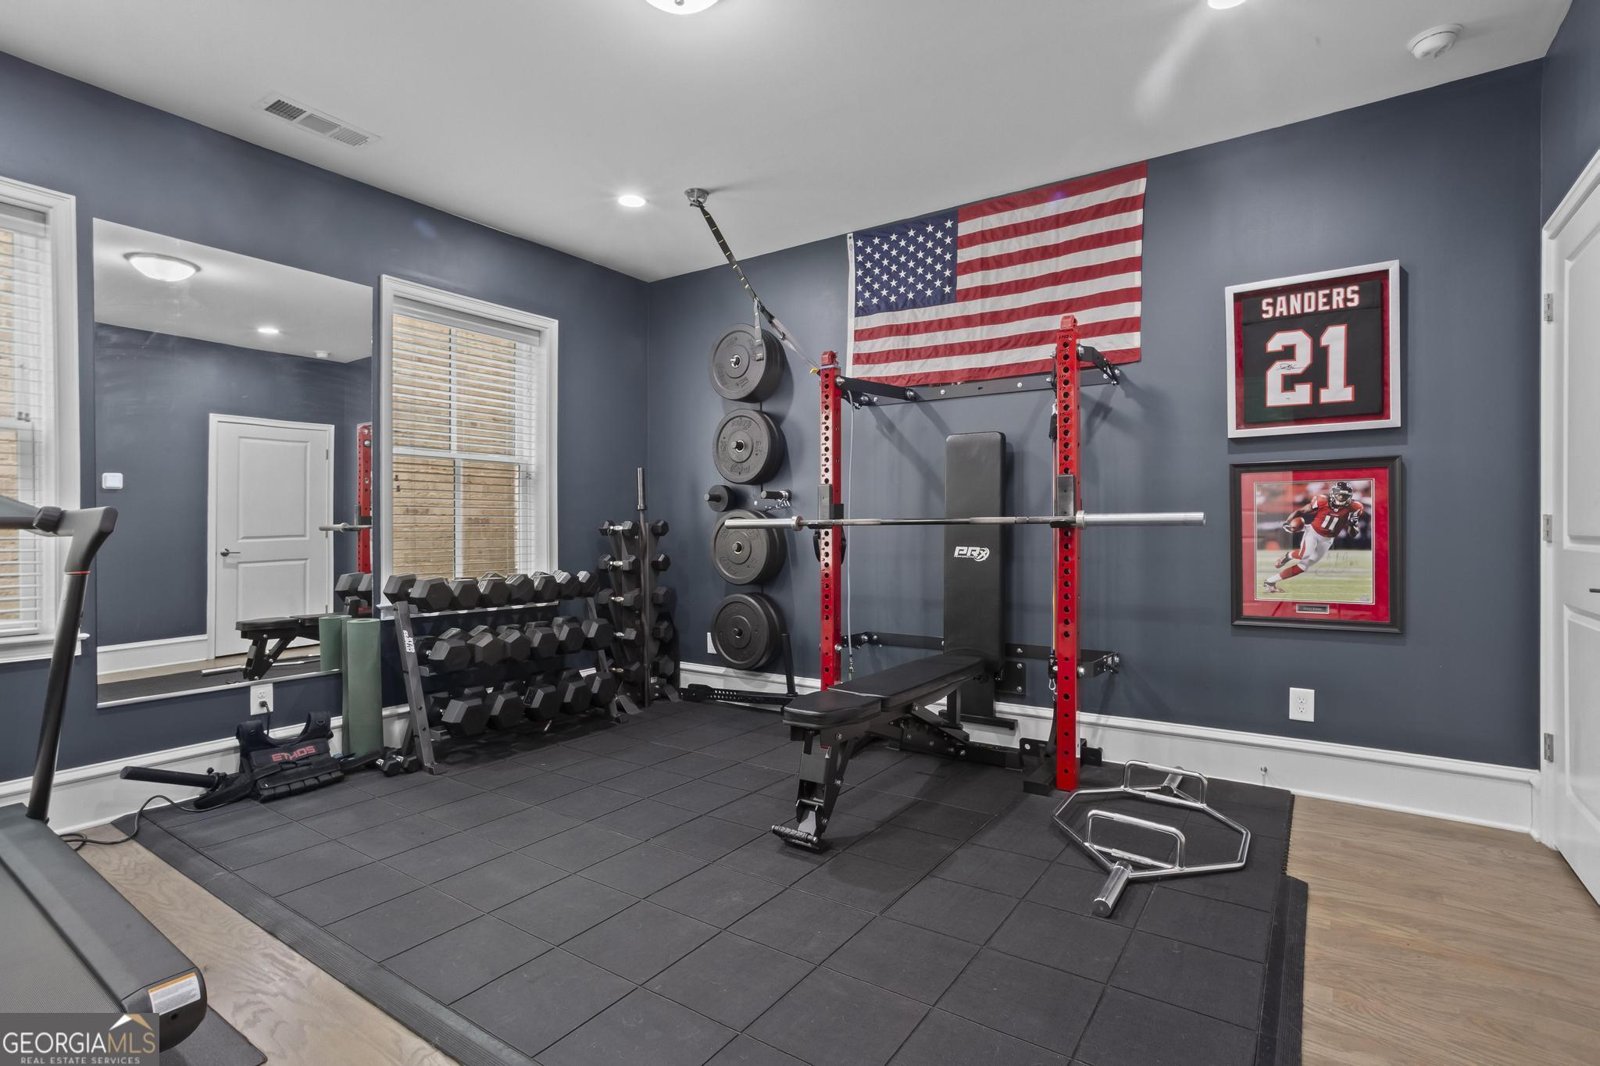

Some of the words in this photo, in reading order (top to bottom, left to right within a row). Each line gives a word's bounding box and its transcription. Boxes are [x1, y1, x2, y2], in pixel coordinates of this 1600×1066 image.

[1261, 284, 1360, 319] SANDERS
[1265, 323, 1355, 407] 21
[1320, 515, 1340, 531] 11
[271, 745, 317, 762] ETHOS
